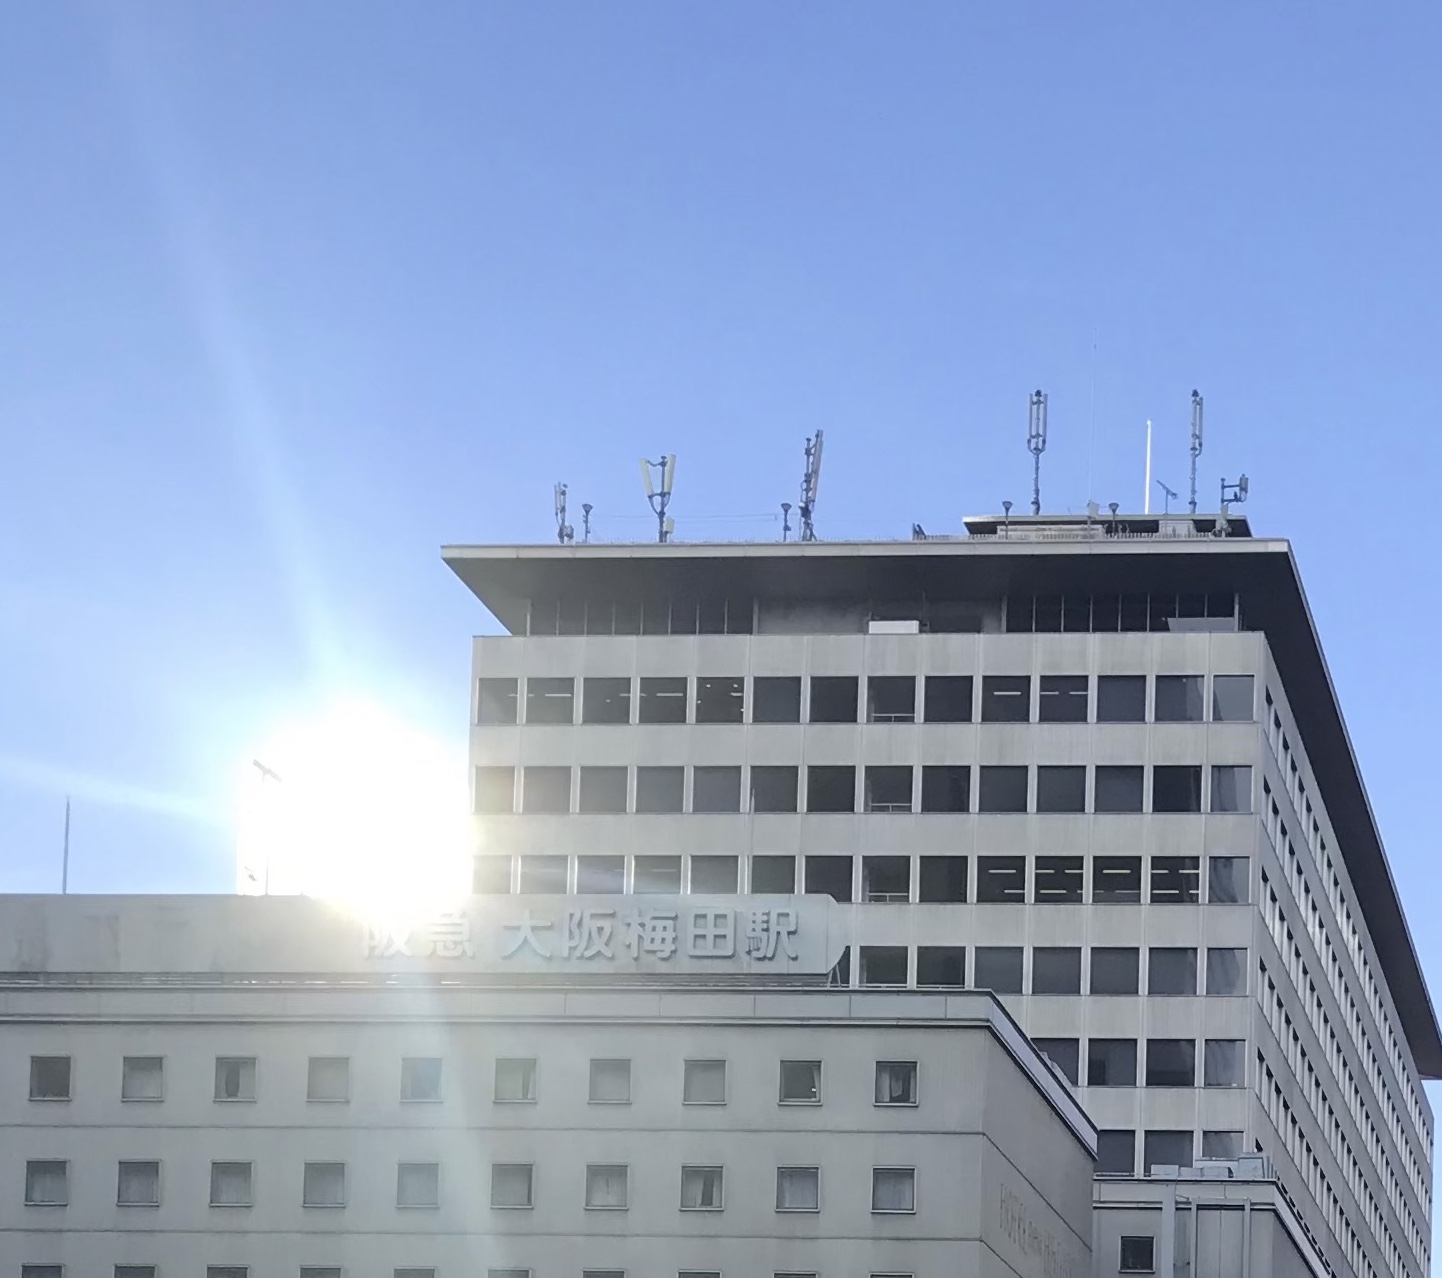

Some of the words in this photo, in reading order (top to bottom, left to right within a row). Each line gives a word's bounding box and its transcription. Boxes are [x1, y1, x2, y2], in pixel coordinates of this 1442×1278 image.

[500, 907, 799, 960] 大阪梅田駅
